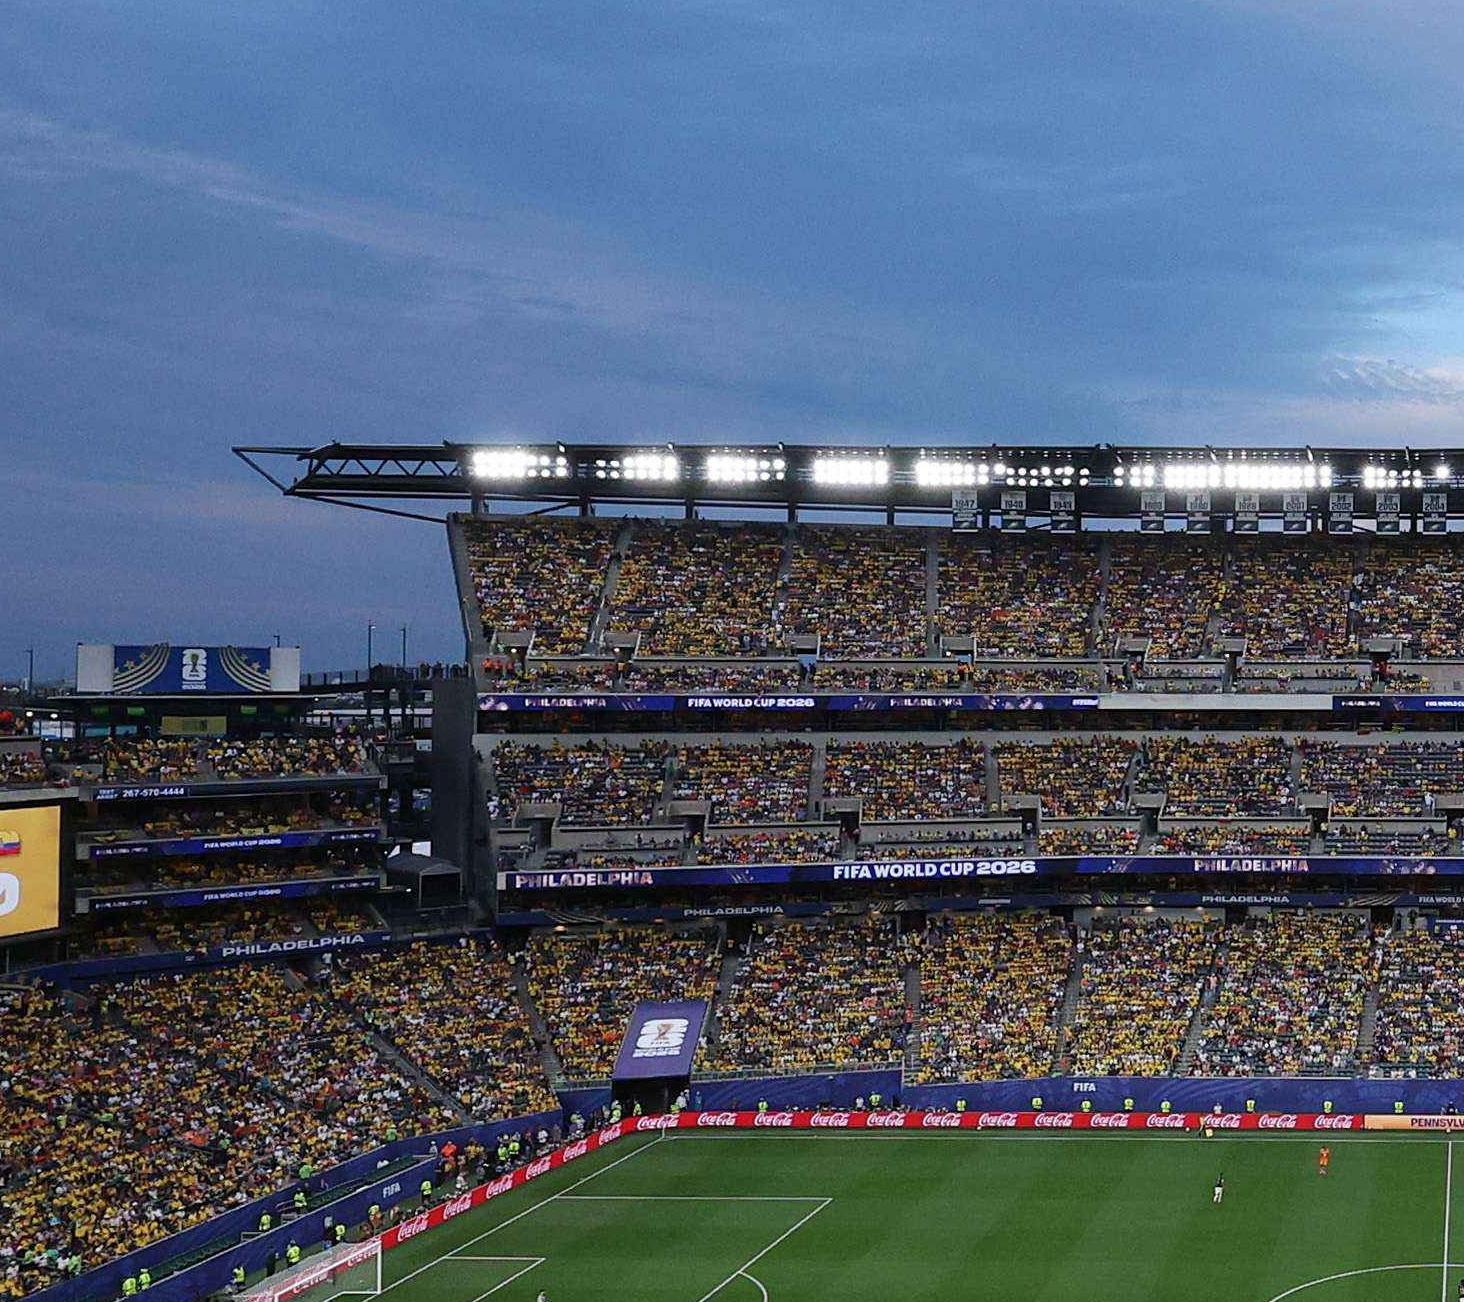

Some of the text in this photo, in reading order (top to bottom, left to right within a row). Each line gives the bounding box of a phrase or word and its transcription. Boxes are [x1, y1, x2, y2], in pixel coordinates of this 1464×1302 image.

[688, 698, 815, 708] FIFA WORLD CUP 2026
[834, 860, 1036, 880] FIFA WORLD CUP 2026
[1194, 859, 1310, 872] PHILADELPHIA
[516, 872, 654, 889] PHILADELPHIA
[684, 905, 784, 917] PHILADELPHIA
[222, 934, 365, 957] PHILADELPHIA
[1073, 1082, 1096, 1093] FIFA
[382, 1182, 401, 1198] FIFA
